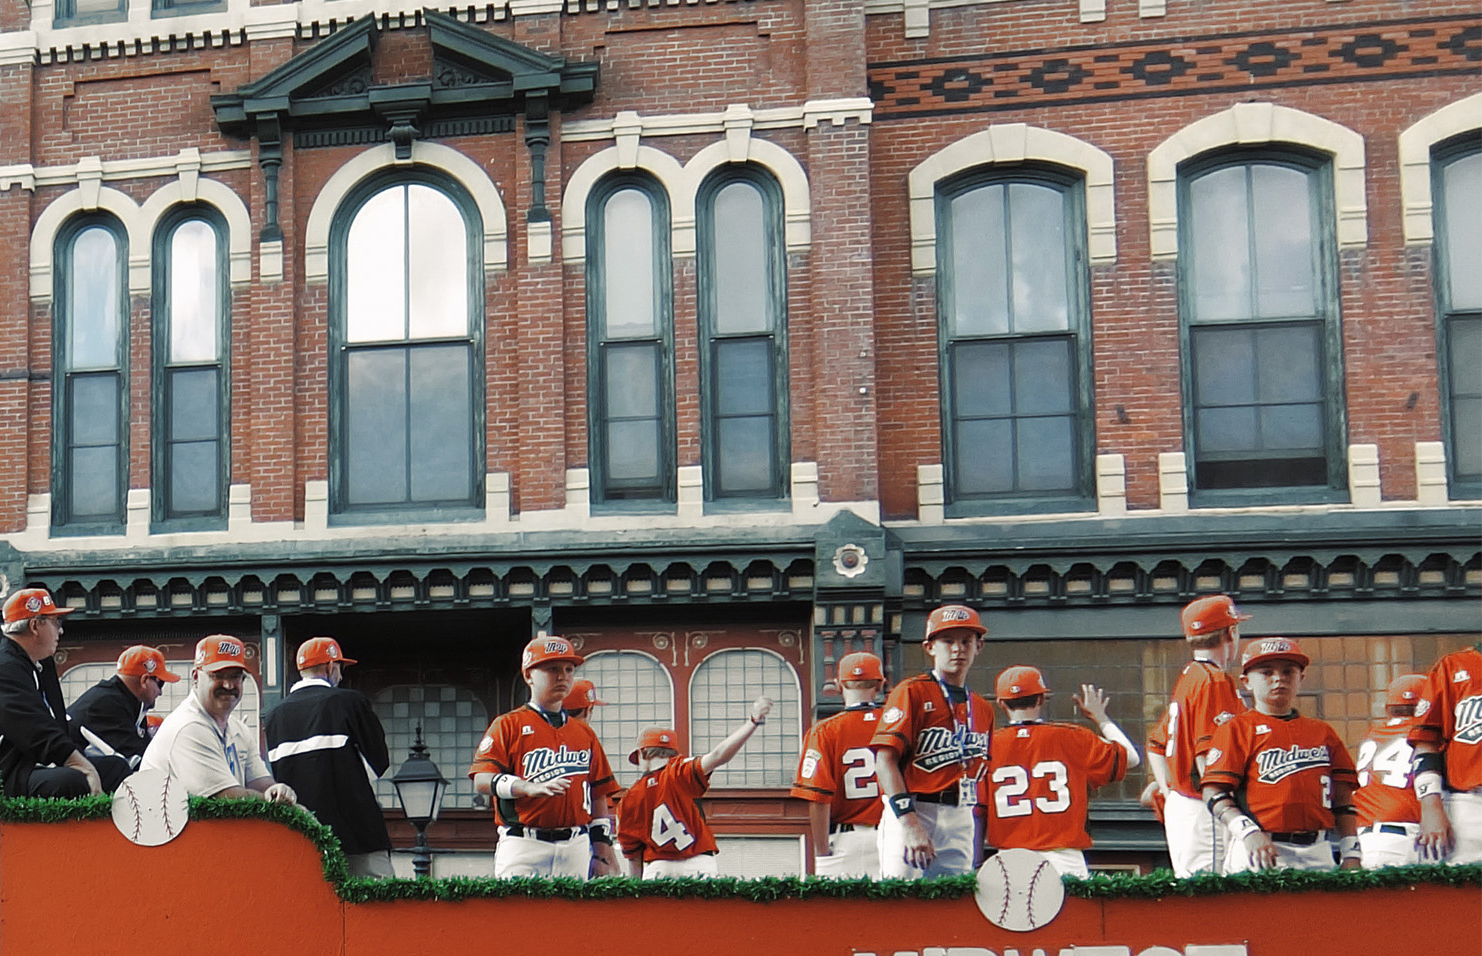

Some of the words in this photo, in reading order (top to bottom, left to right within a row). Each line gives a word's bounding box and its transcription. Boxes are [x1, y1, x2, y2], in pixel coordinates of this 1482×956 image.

[522, 745, 591, 779] Midwe
[1256, 744, 1330, 775] Midwe
[992, 760, 1071, 818] 23
[651, 803, 695, 851] 4
